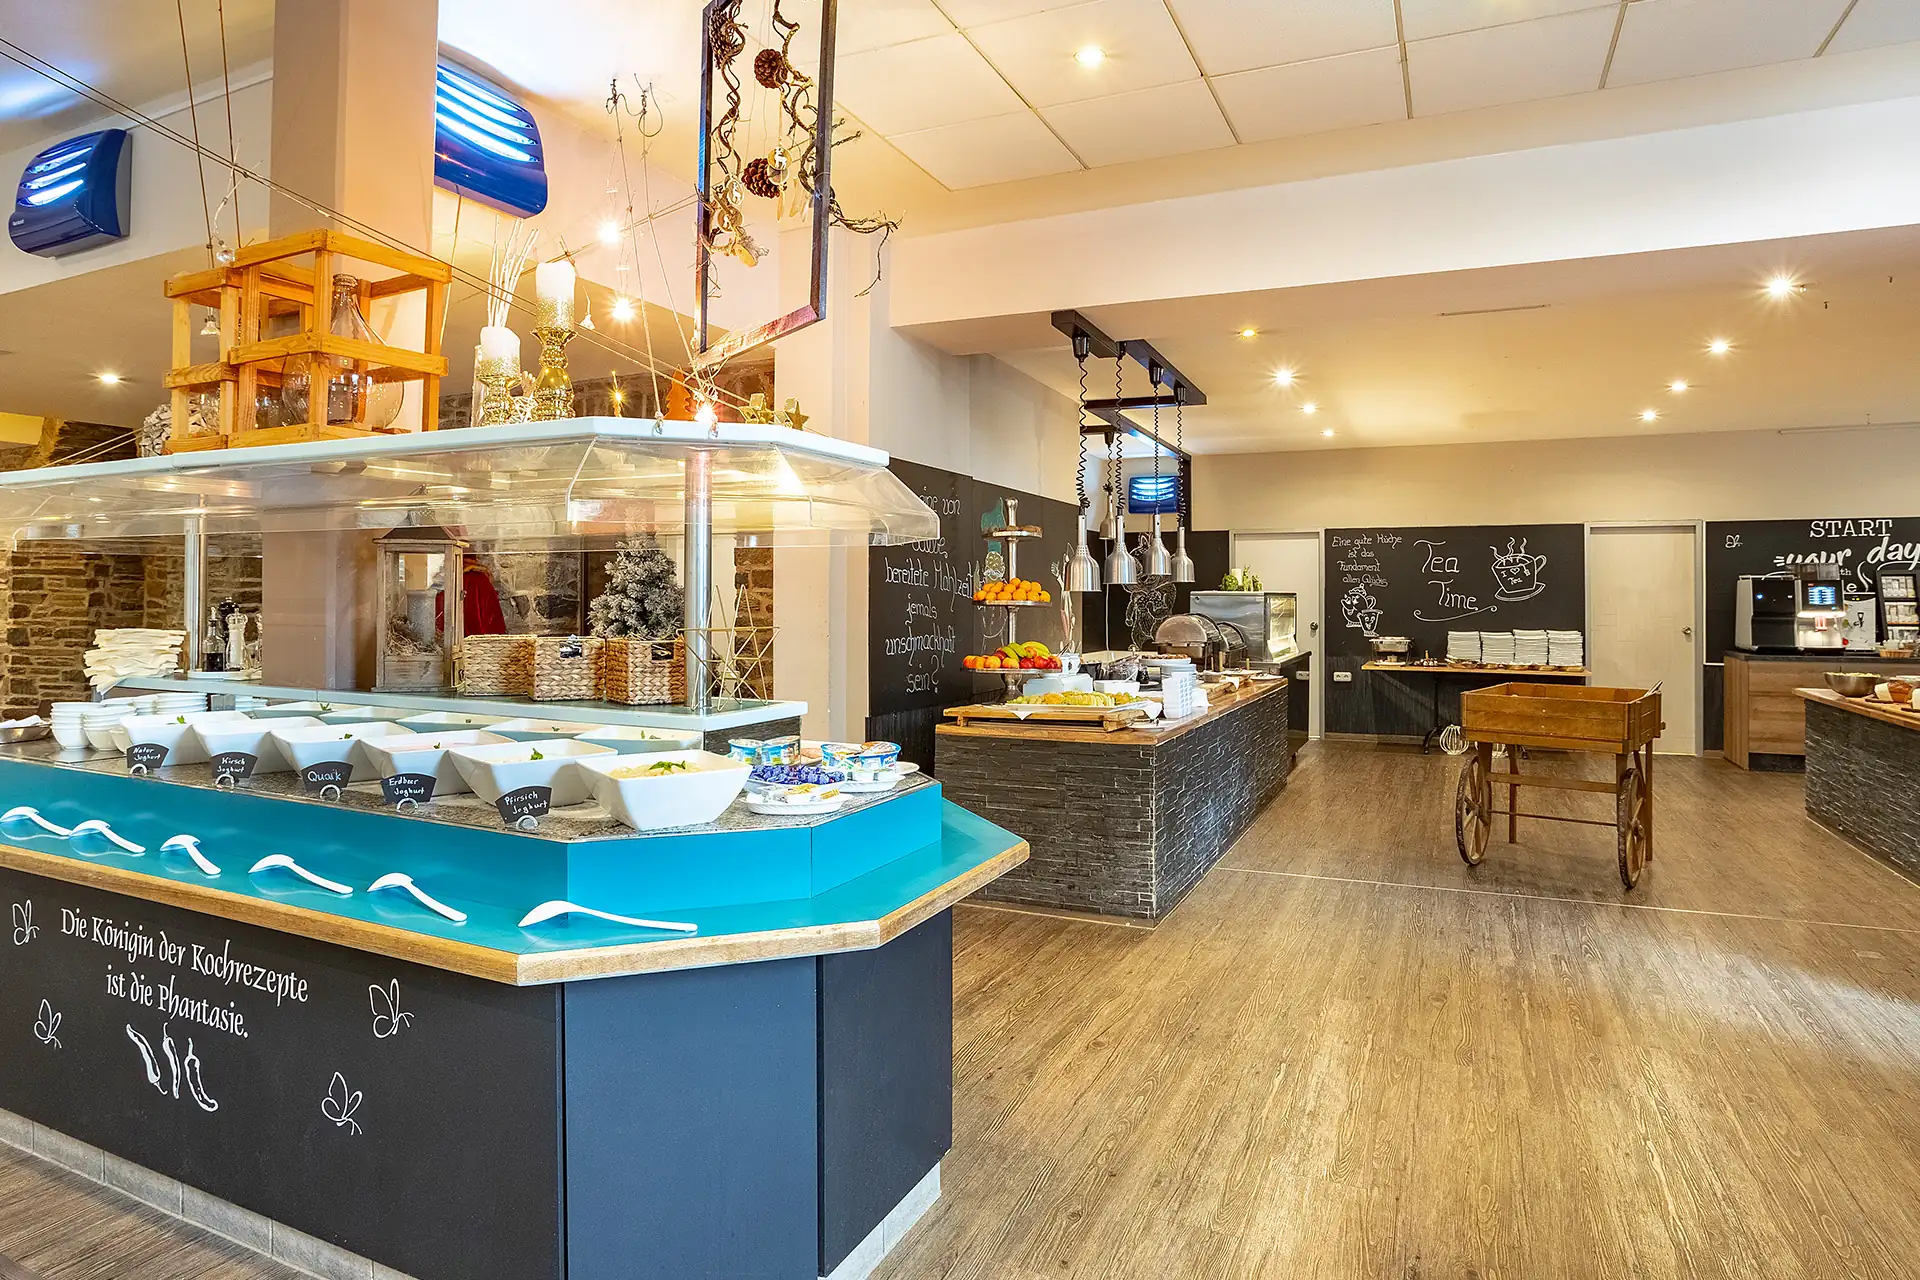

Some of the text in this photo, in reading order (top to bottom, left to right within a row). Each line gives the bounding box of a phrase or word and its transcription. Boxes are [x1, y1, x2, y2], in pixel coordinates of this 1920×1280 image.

[1810, 519, 1893, 538] START
[1331, 533, 1403, 550] Eine gute Küche
[1360, 547, 1375, 558] das
[1866, 536, 1920, 571] day
[1413, 539, 1460, 574] Tea
[884, 556, 974, 613] bereitete Mahlzeit
[1507, 577, 1523, 585] Tea
[1427, 579, 1478, 611] Time
[904, 593, 938, 626] jemals
[884, 622, 956, 668] unschmackhaft
[906, 654, 940, 694] sein?
[221, 756, 246, 765] Kirsch
[388, 776, 419, 786] Erdbeer
[393, 787, 425, 797] Joghurt
[504, 790, 538, 806] Pfirsich
[512, 799, 548, 815] Joghurt
[61, 908, 309, 1006] Die Königin der Kochrezepte
[106, 964, 249, 1038] ist die Phantasie.
